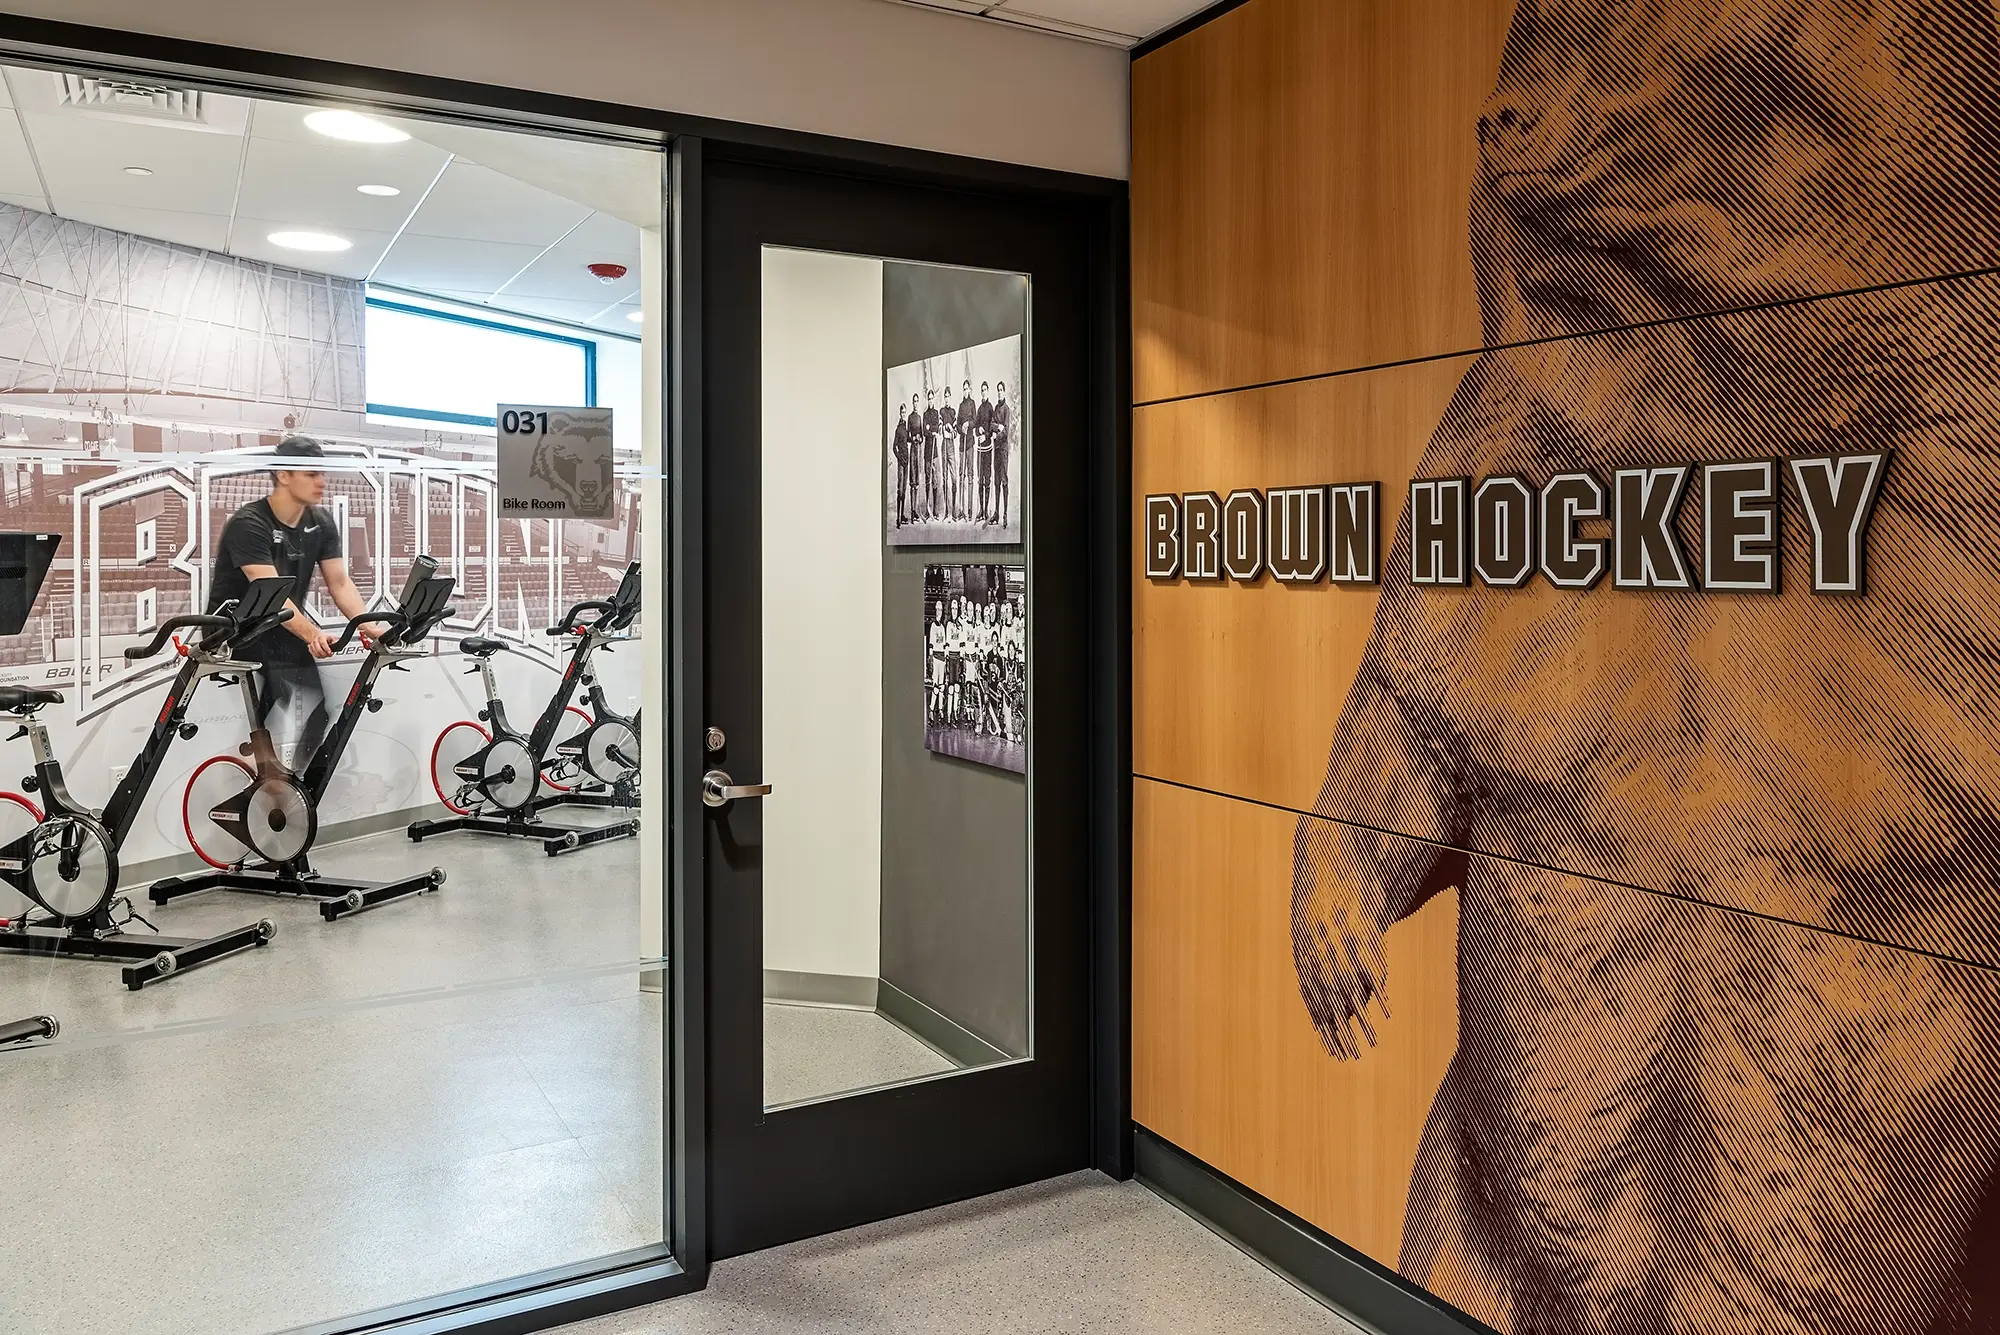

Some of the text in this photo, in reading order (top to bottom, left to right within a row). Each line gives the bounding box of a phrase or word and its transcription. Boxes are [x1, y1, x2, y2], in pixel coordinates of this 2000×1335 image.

[502, 409, 548, 435] 031
[503, 498, 566, 509] Bike Room
[1145, 449, 1892, 596] BROWN HOCKEY
[160, 695, 175, 723] KEISER
